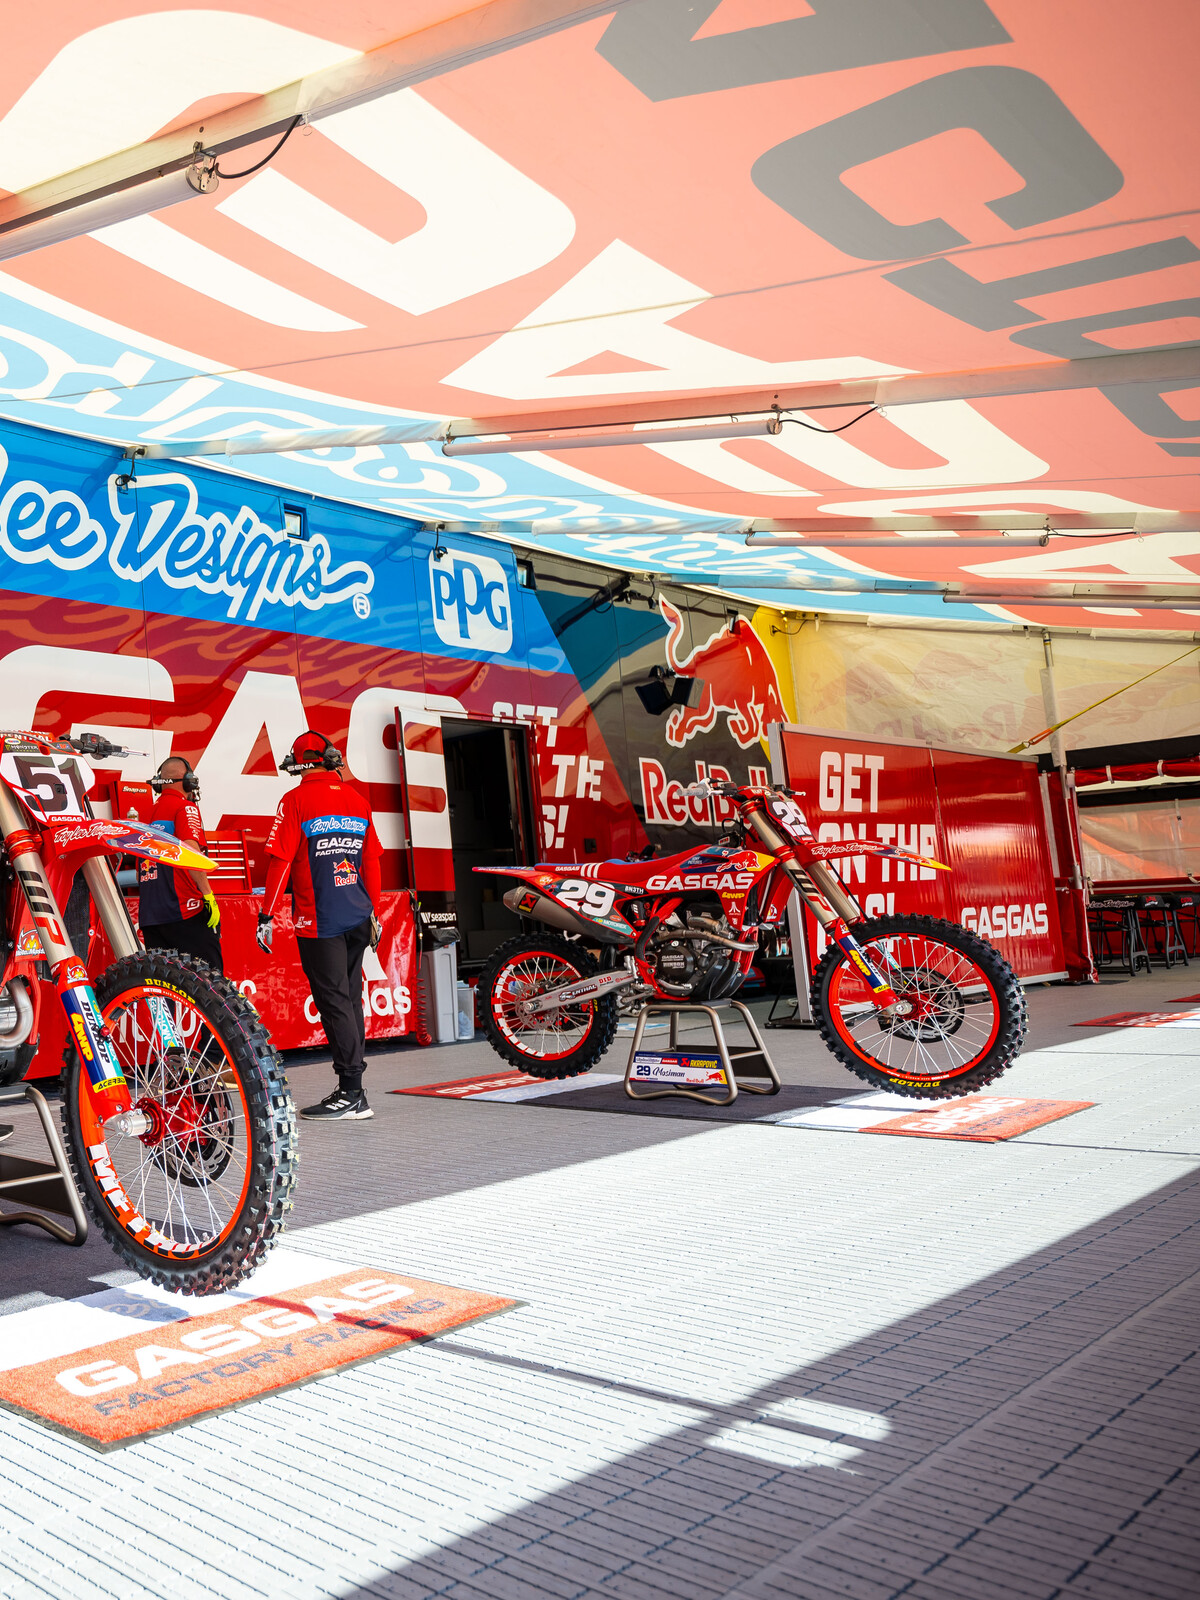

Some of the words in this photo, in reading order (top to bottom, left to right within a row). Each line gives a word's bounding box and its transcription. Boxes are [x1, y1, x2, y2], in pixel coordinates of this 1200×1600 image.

[108, 472, 375, 622] Designs
[433, 558, 508, 639] PPG
[287, 763, 315, 771] SENA
[13, 756, 87, 812] 51
[639, 757, 706, 827] Red
[820, 751, 885, 815] GET
[310, 818, 328, 833] Troy
[772, 801, 812, 837] 29
[54, 826, 73, 846] Troy
[70, 826, 90, 839] Lee
[87, 822, 130, 838] Designs
[811, 845, 831, 857] Troy
[846, 843, 885, 853] Designs
[818, 822, 867, 884] ON
[876, 824, 937, 883] THE
[335, 875, 350, 886] Red
[625, 886, 644, 895] BN3TH
[646, 873, 755, 890] GASGAS
[556, 879, 615, 917] 29
[603, 920, 627, 930] MOTOREX
[961, 902, 1049, 940] GASGAS
[145, 978, 196, 1004] DUNLOP
[599, 976, 612, 984] DID
[637, 1065, 651, 1076] 29
[889, 1077, 941, 1088] DUNLOP
[435, 1075, 541, 1095] ASGAS
[901, 1098, 1026, 1132] GASGAS
[56, 1278, 415, 1398] GASGAS
[94, 1342, 297, 1416] FACTORY
[304, 1298, 445, 1349] RACING
